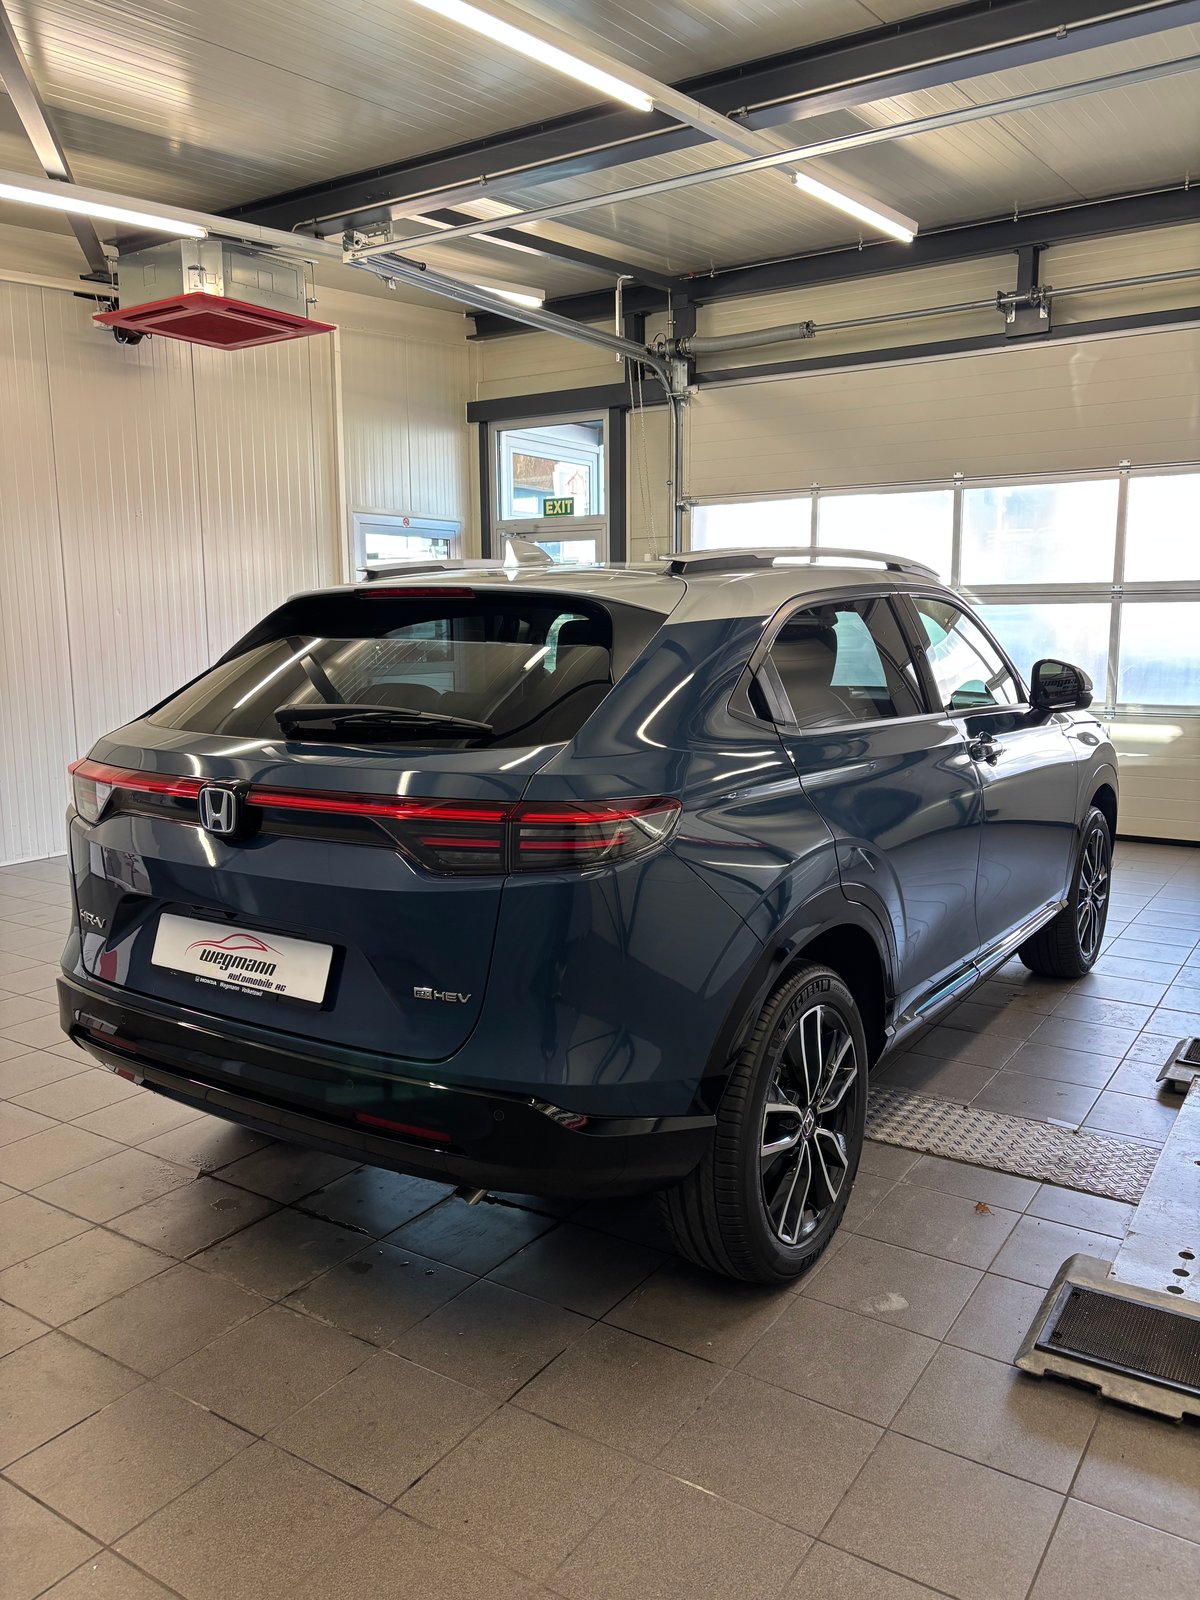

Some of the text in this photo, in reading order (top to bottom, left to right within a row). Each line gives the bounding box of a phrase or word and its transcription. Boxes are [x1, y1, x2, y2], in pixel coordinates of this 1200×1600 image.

[545, 500, 573, 515] EXIT
[200, 948, 277, 976] wegmann
[275, 983, 287, 992] AG
[783, 979, 831, 1027] MICHELIN
